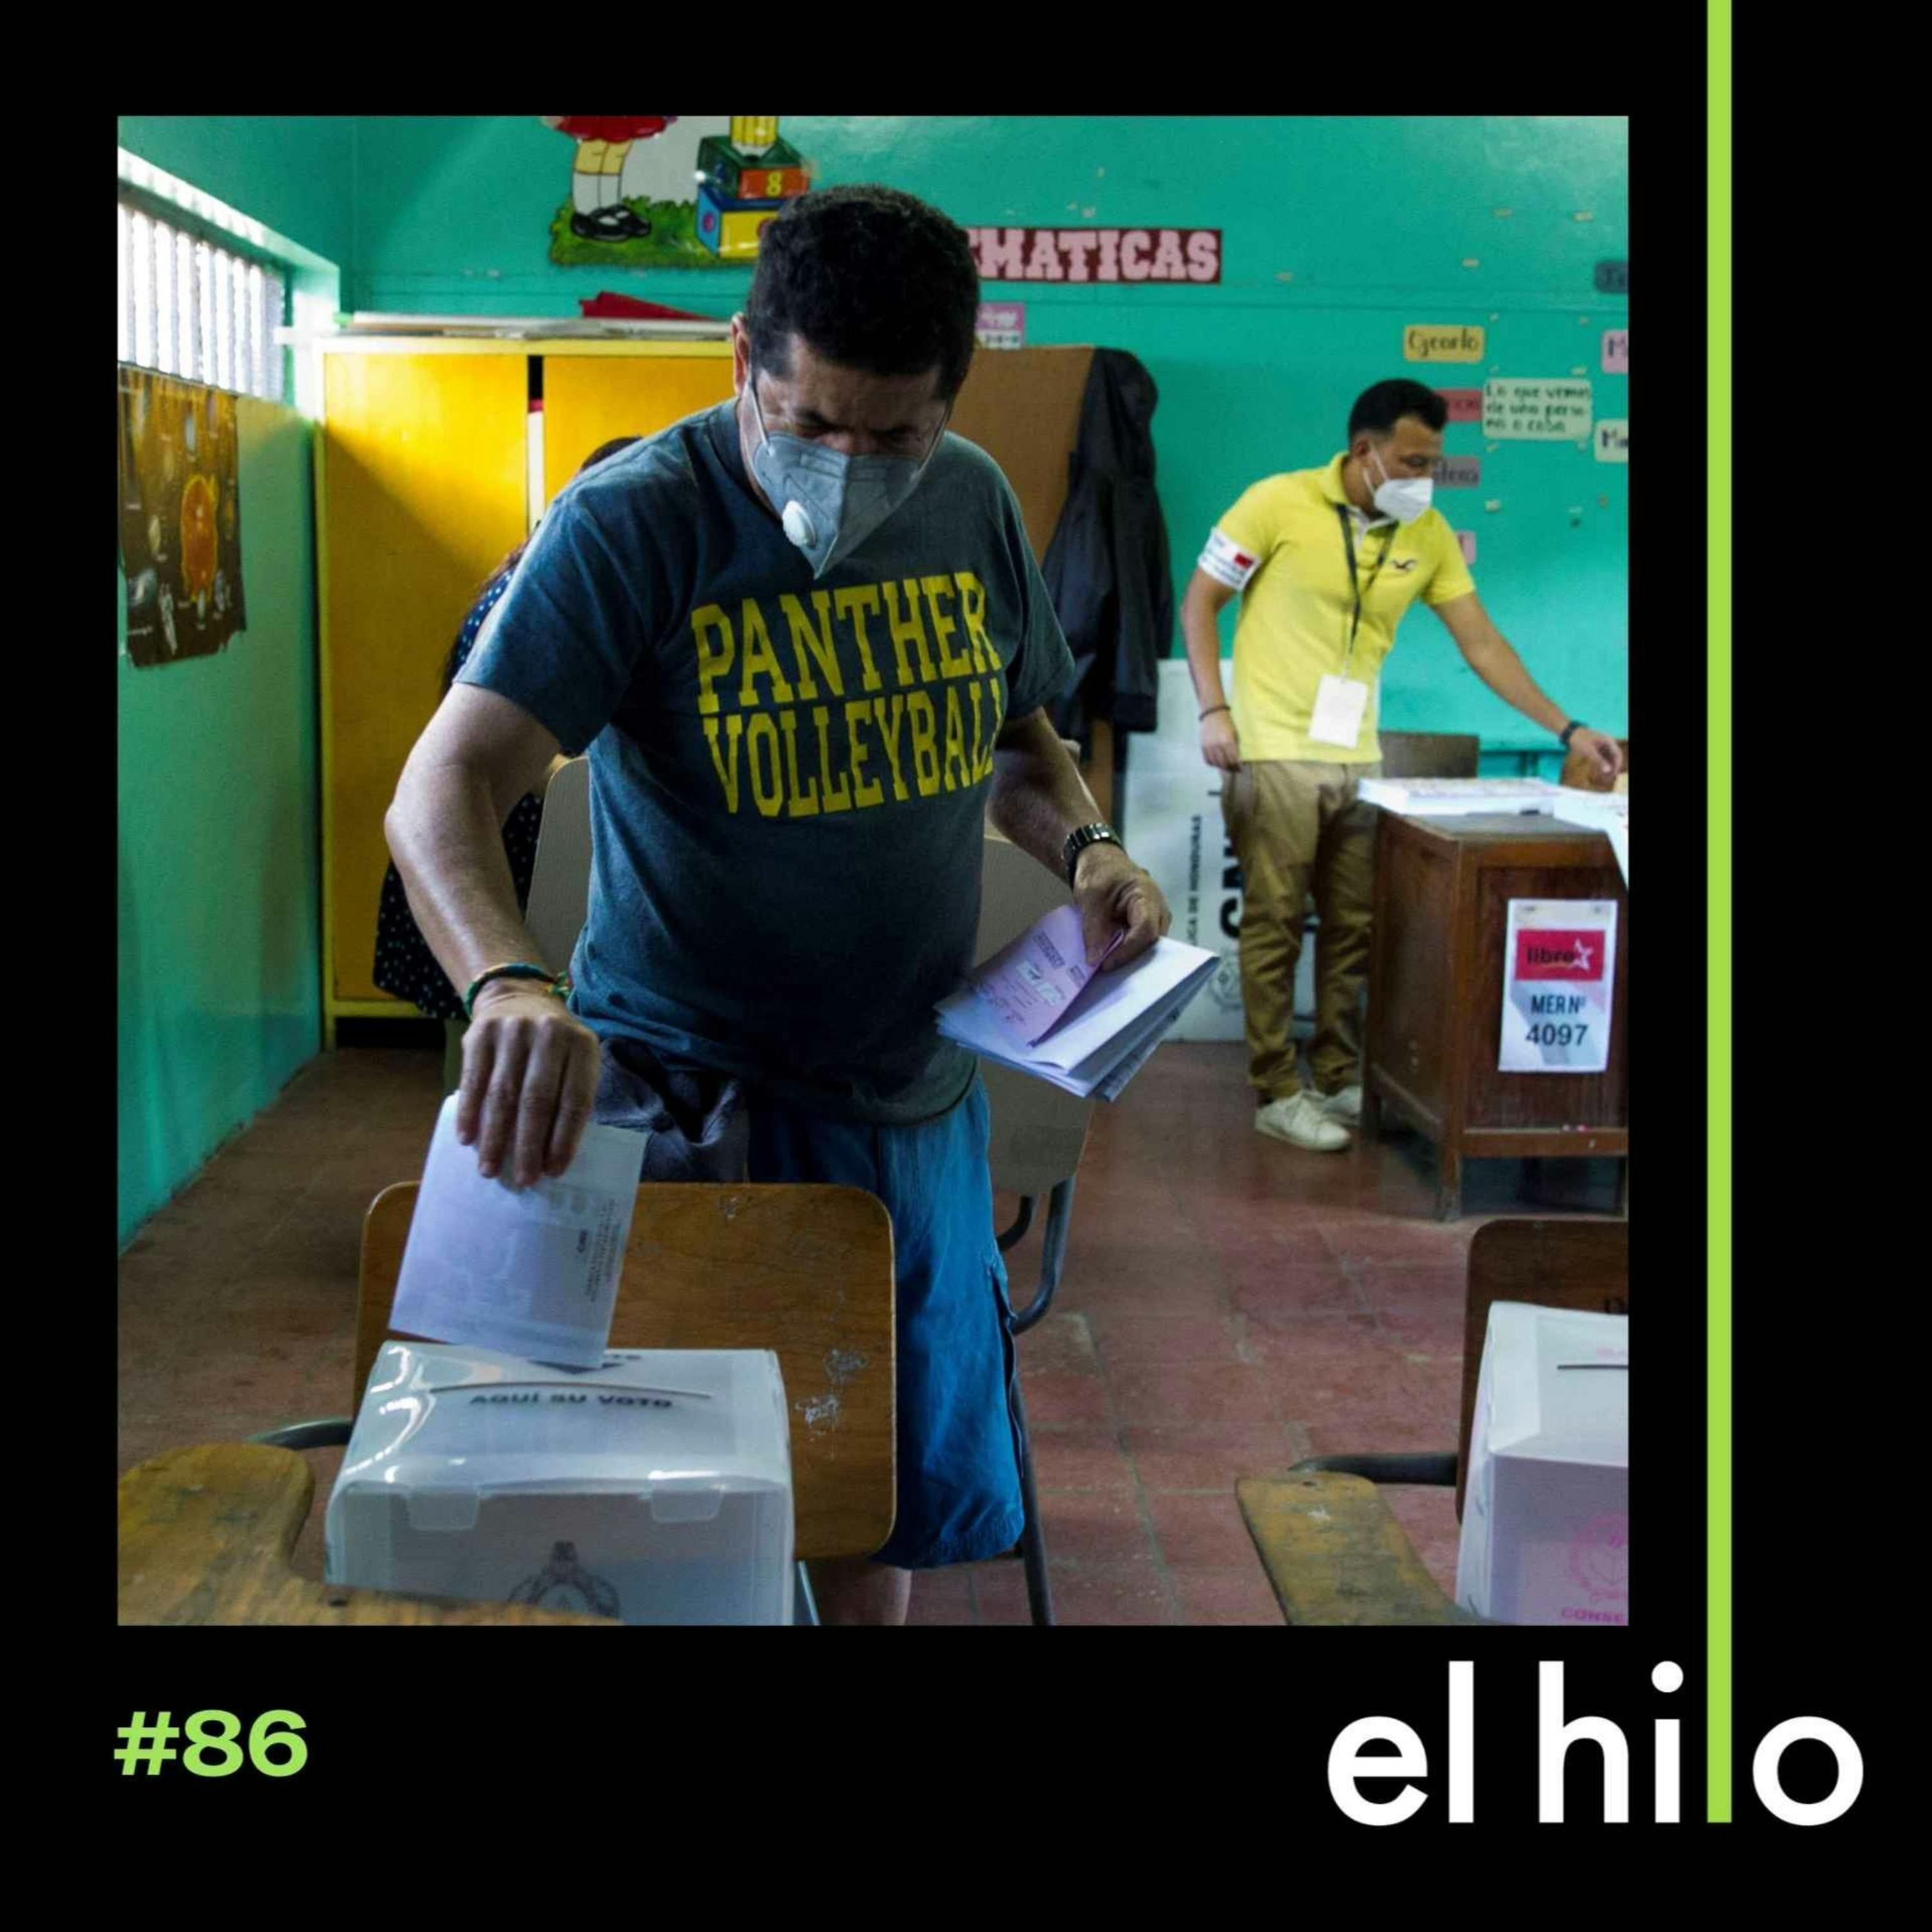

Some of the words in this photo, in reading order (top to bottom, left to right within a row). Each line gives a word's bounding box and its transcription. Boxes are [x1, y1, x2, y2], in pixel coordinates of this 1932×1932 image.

[766, 171, 783, 198] 8
[691, 572, 1001, 714] PANTHER
[702, 677, 1002, 817] VOLLEYBALL
[1528, 947, 1575, 964] libre
[1531, 995, 1566, 1014] MER
[1526, 1023, 1588, 1046] 4097
[550, 1394, 587, 1403] SU
[599, 1396, 672, 1408] VOTO
